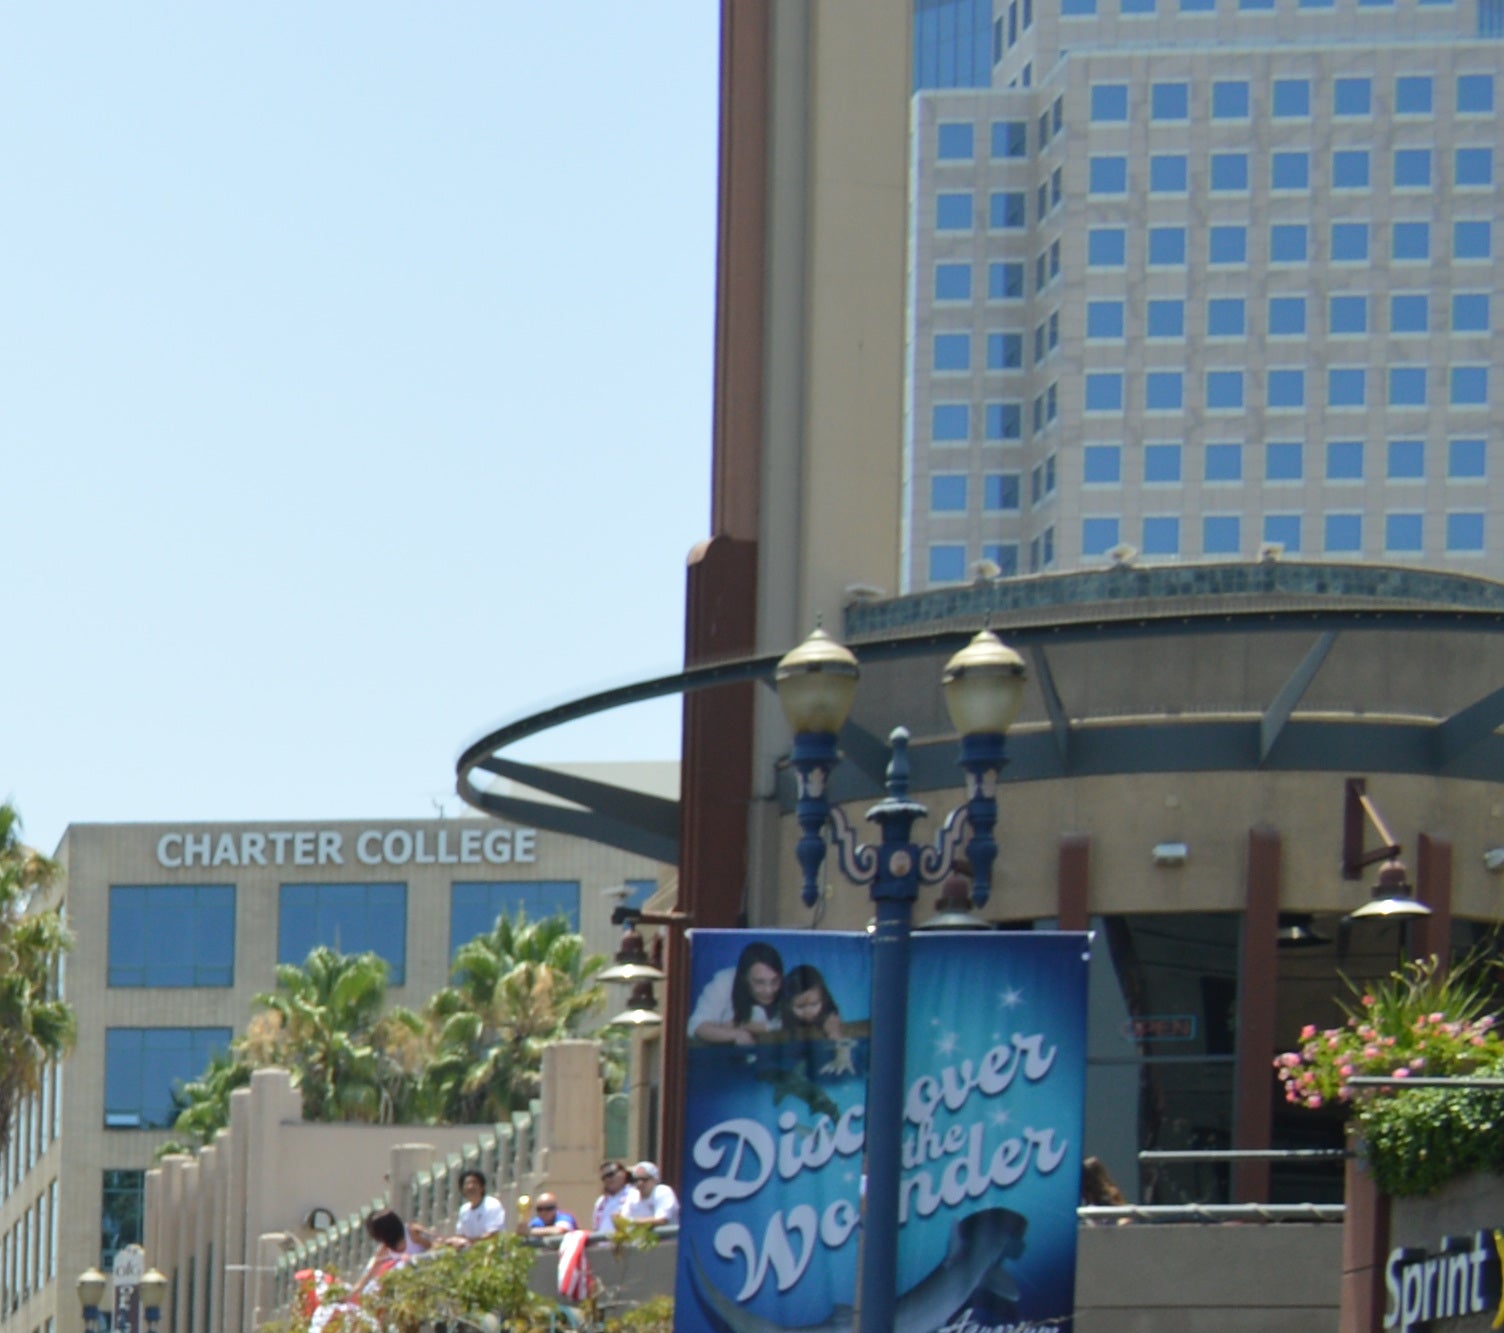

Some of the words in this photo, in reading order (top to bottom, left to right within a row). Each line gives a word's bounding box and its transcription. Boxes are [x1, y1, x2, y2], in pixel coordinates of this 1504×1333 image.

[156, 830, 345, 869] CHARTER
[357, 828, 537, 866] COLLEGE
[901, 1118, 967, 1170] the
